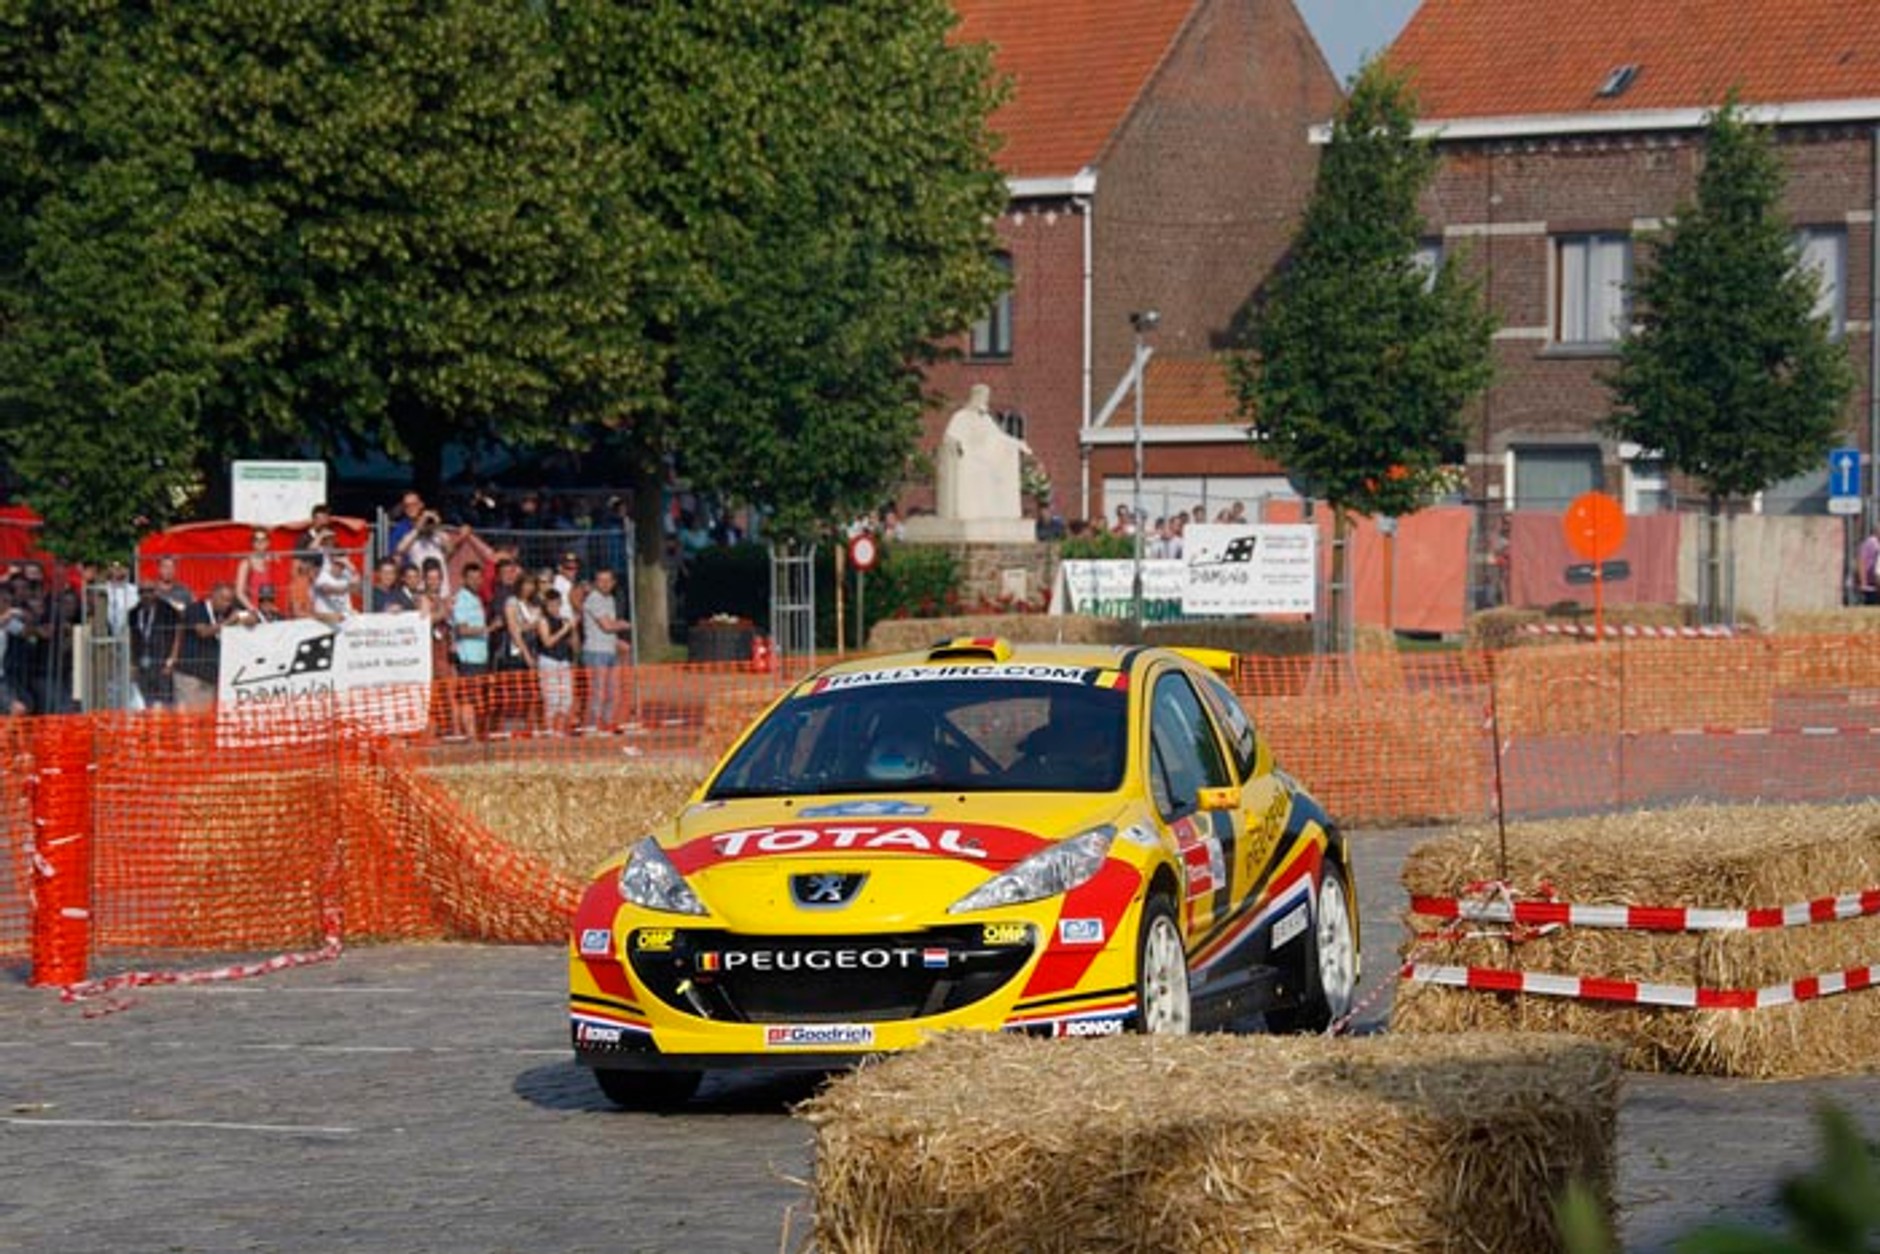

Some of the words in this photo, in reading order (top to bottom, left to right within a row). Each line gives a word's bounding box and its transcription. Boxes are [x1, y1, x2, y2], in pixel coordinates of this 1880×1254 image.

[711, 827, 989, 858] TOTAL
[982, 923, 1028, 945] OMP
[724, 949, 917, 971] PEUGEOT
[767, 1027, 873, 1045] BFGoodrich
